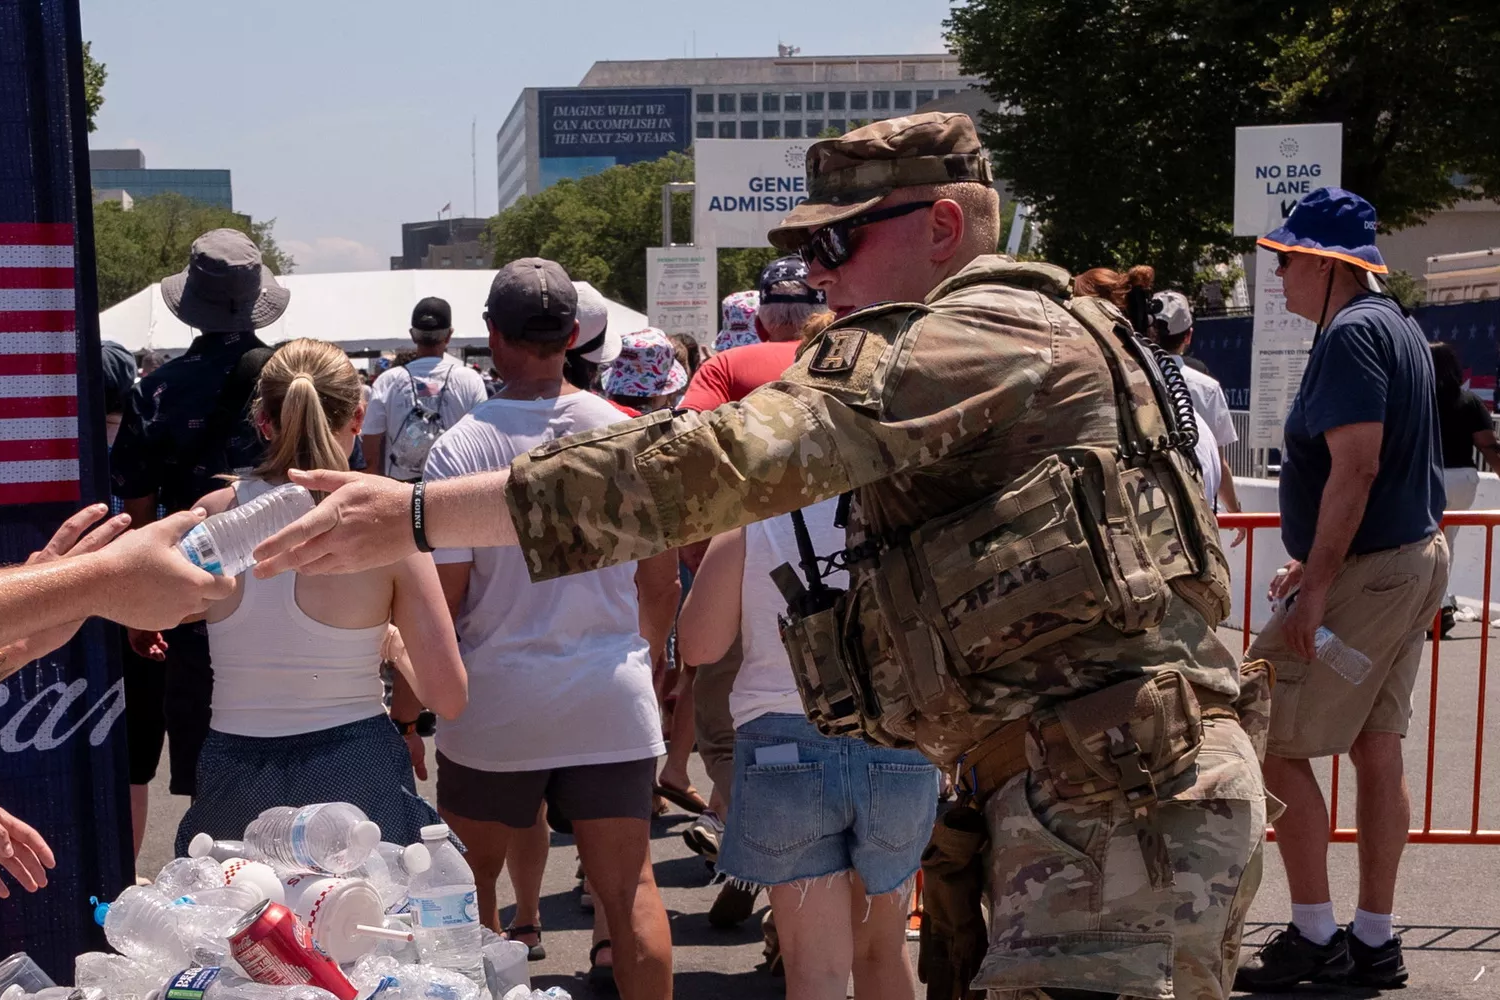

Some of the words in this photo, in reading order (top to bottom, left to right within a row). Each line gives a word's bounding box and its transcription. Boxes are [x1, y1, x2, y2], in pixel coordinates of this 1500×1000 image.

[553, 104, 605, 116] IMAGINE
[608, 105, 643, 116] WHAT
[646, 104, 666, 115] WE
[553, 120, 578, 130] CAN
[580, 118, 657, 130] ACCOMPLISH
[658, 118, 673, 128] IN
[554, 133, 578, 144] THE
[580, 133, 614, 143] NEXT
[615, 133, 634, 143] 250
[1255, 165, 1281, 179] NO
[1286, 163, 1321, 178] BAG
[749, 177, 809, 192] GENE
[1266, 181, 1310, 195] LANE
[708, 196, 809, 212] ADMISSI
